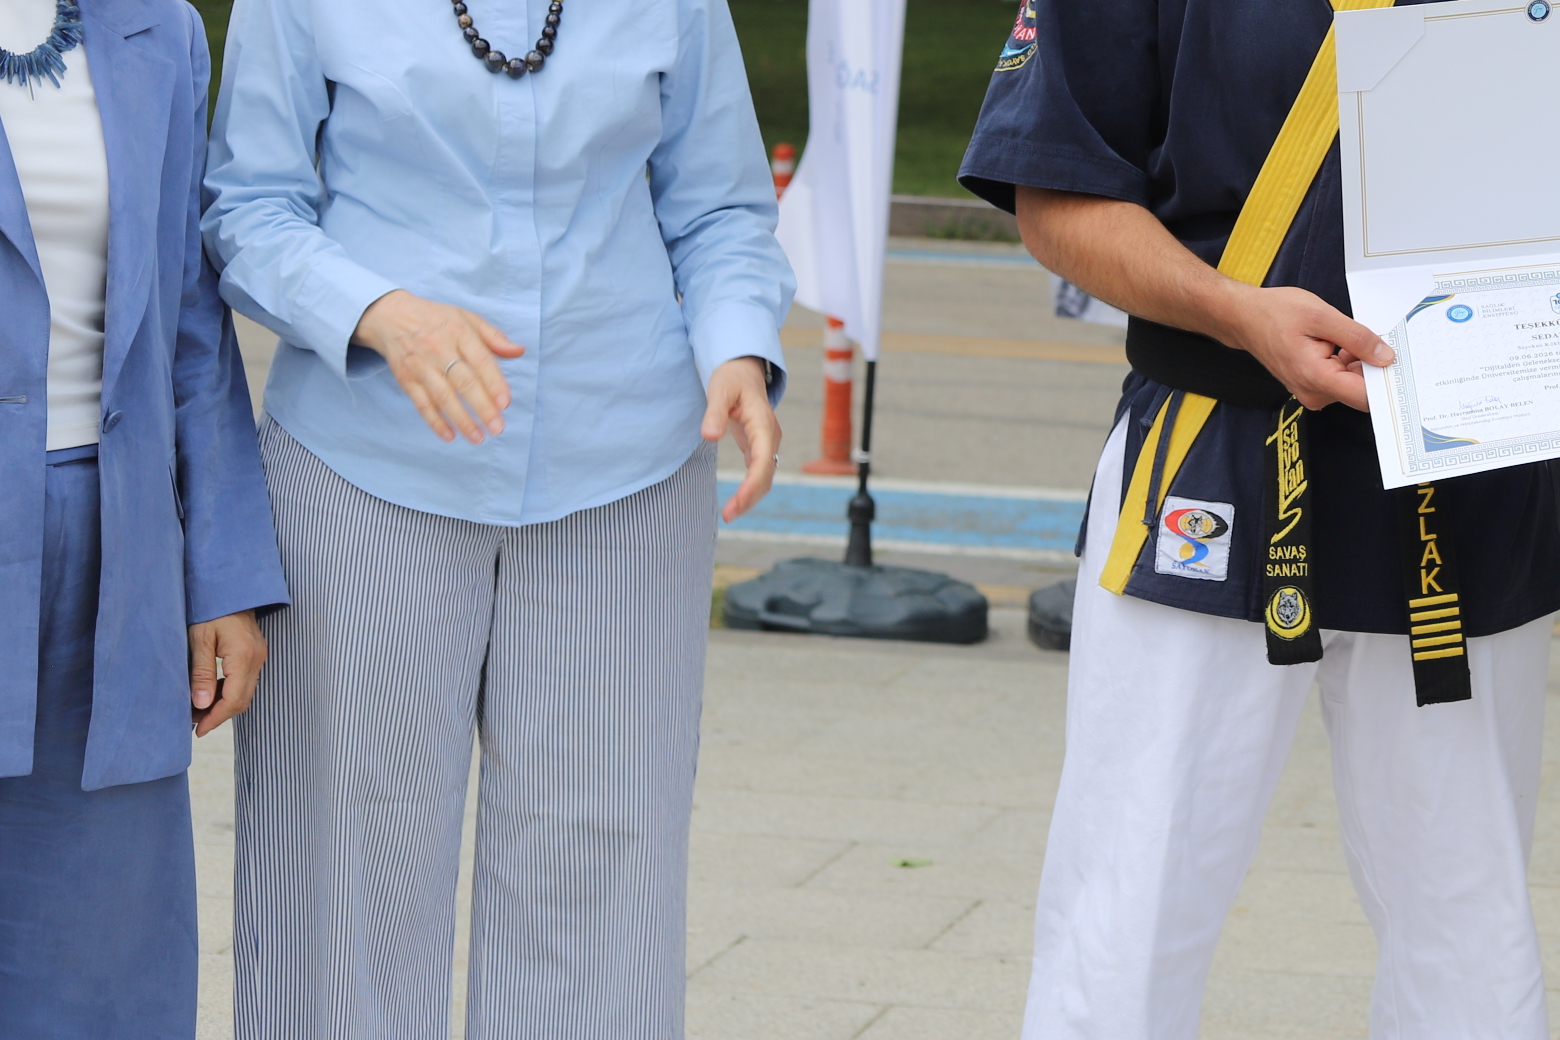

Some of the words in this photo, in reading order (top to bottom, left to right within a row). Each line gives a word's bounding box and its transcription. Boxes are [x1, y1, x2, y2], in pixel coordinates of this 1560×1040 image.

[1508, 351, 1553, 362] 09.06.2026
[1435, 375, 1480, 387] etkinliğinde
[1481, 365, 1537, 379] Üniversitemize
[1544, 383, 1560, 391] Prof.
[1484, 404, 1509, 412] BOLAY
[1510, 400, 1534, 408] BELEN
[1418, 482, 1444, 595] ZLAK
[1269, 544, 1307, 561] SAVAŞ
[1266, 562, 1308, 577] SANATI
